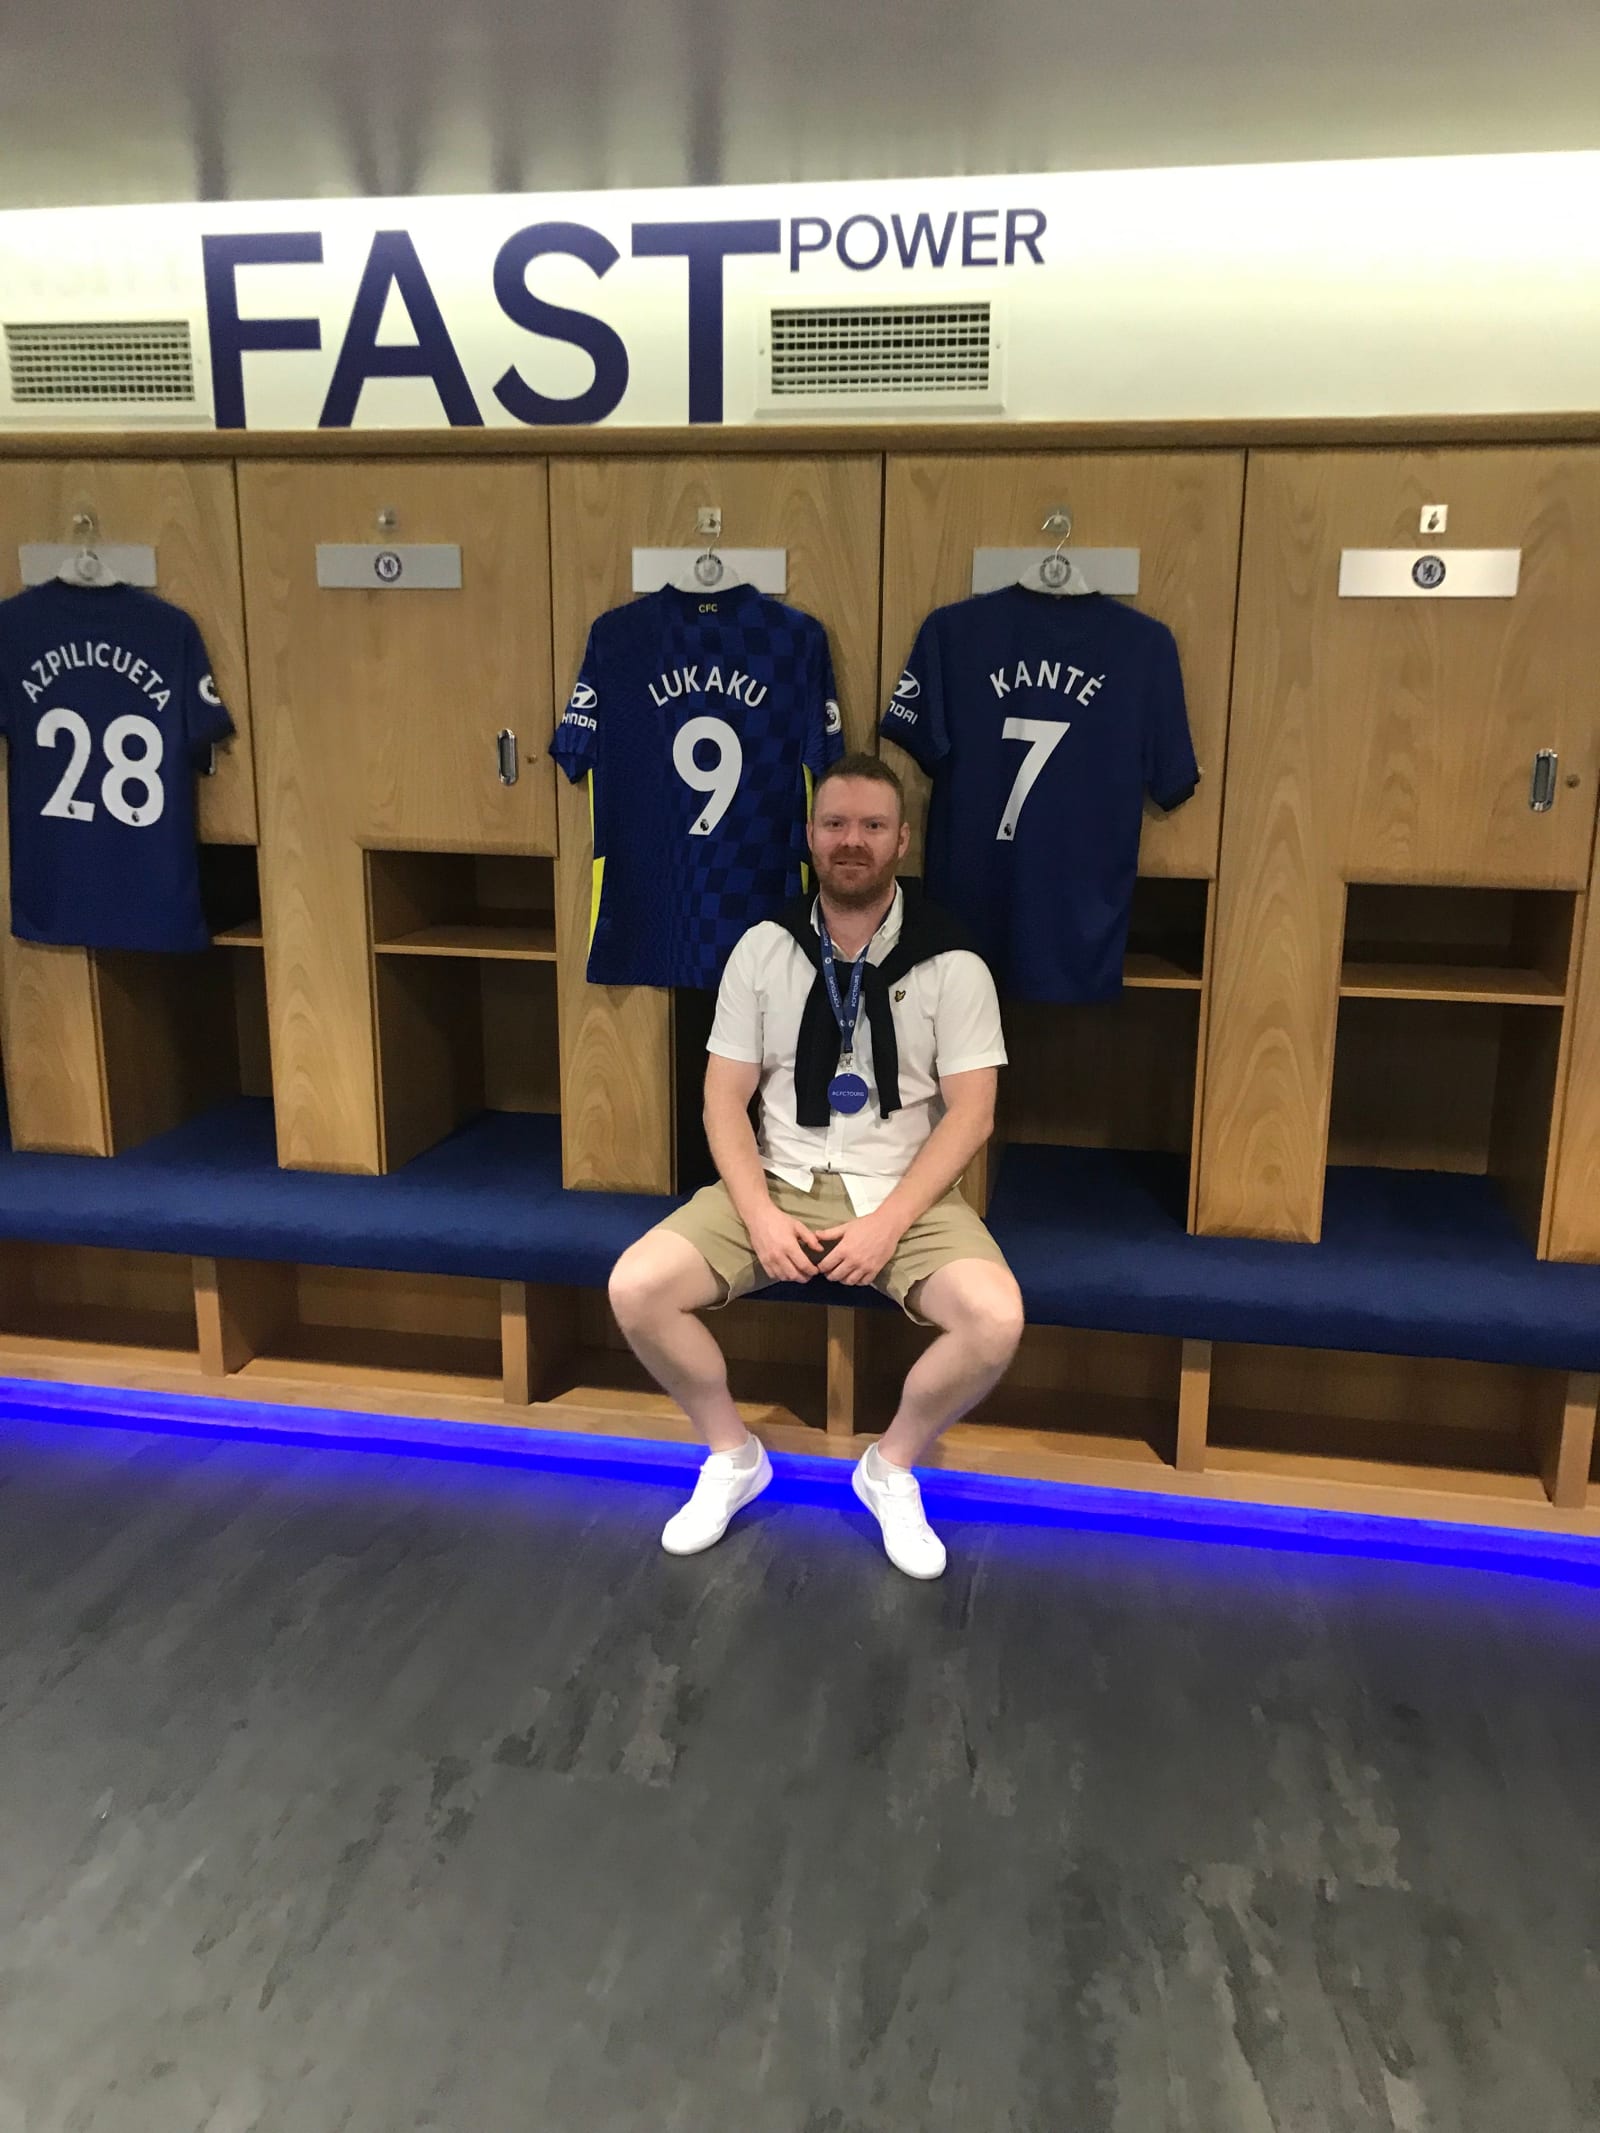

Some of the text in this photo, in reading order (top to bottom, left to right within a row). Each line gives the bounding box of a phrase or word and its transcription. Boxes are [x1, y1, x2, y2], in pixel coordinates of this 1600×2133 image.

[790, 208, 1049, 273] POWER
[202, 221, 781, 429] FAST
[698, 603, 718, 613] CFC
[22, 640, 171, 712] AZPILICUETA
[648, 665, 768, 707] LUKAKU
[989, 660, 1107, 706] KANTÉ
[36, 708, 164, 827] 28
[673, 716, 743, 835] 9
[996, 717, 1071, 841] 7
